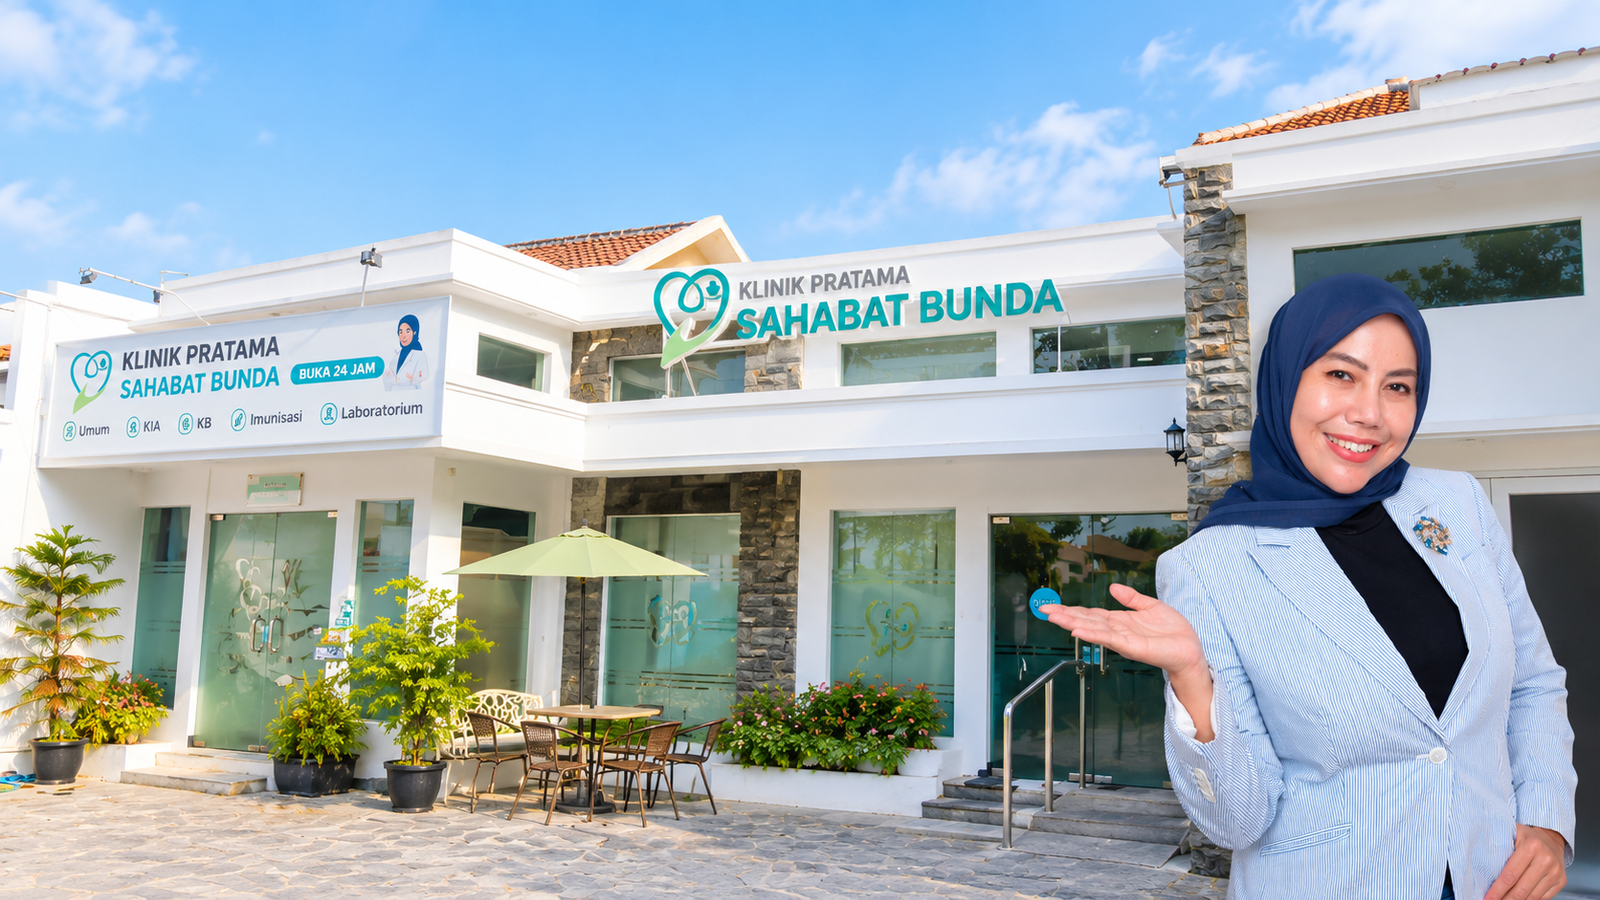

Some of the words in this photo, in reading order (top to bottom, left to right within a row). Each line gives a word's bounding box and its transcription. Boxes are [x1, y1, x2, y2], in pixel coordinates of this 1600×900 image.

[739, 276, 804, 300] KLINIK
[810, 265, 910, 293] PRATAMA
[736, 293, 909, 340] SAHABAT
[920, 279, 1063, 323] BUNDA
[122, 346, 181, 371] KLINIK
[186, 336, 280, 364] PRATAMA
[299, 366, 331, 380] BUKA
[333, 364, 348, 377] 24
[350, 362, 376, 375] JAM
[120, 373, 206, 399] SAHABAT
[210, 366, 280, 392] BUNDA
[250, 410, 303, 426] Imunisasi
[341, 402, 423, 419] Laboratorium
[79, 425, 110, 437] Umum
[143, 420, 161, 433] KIA
[197, 417, 212, 430] KB
